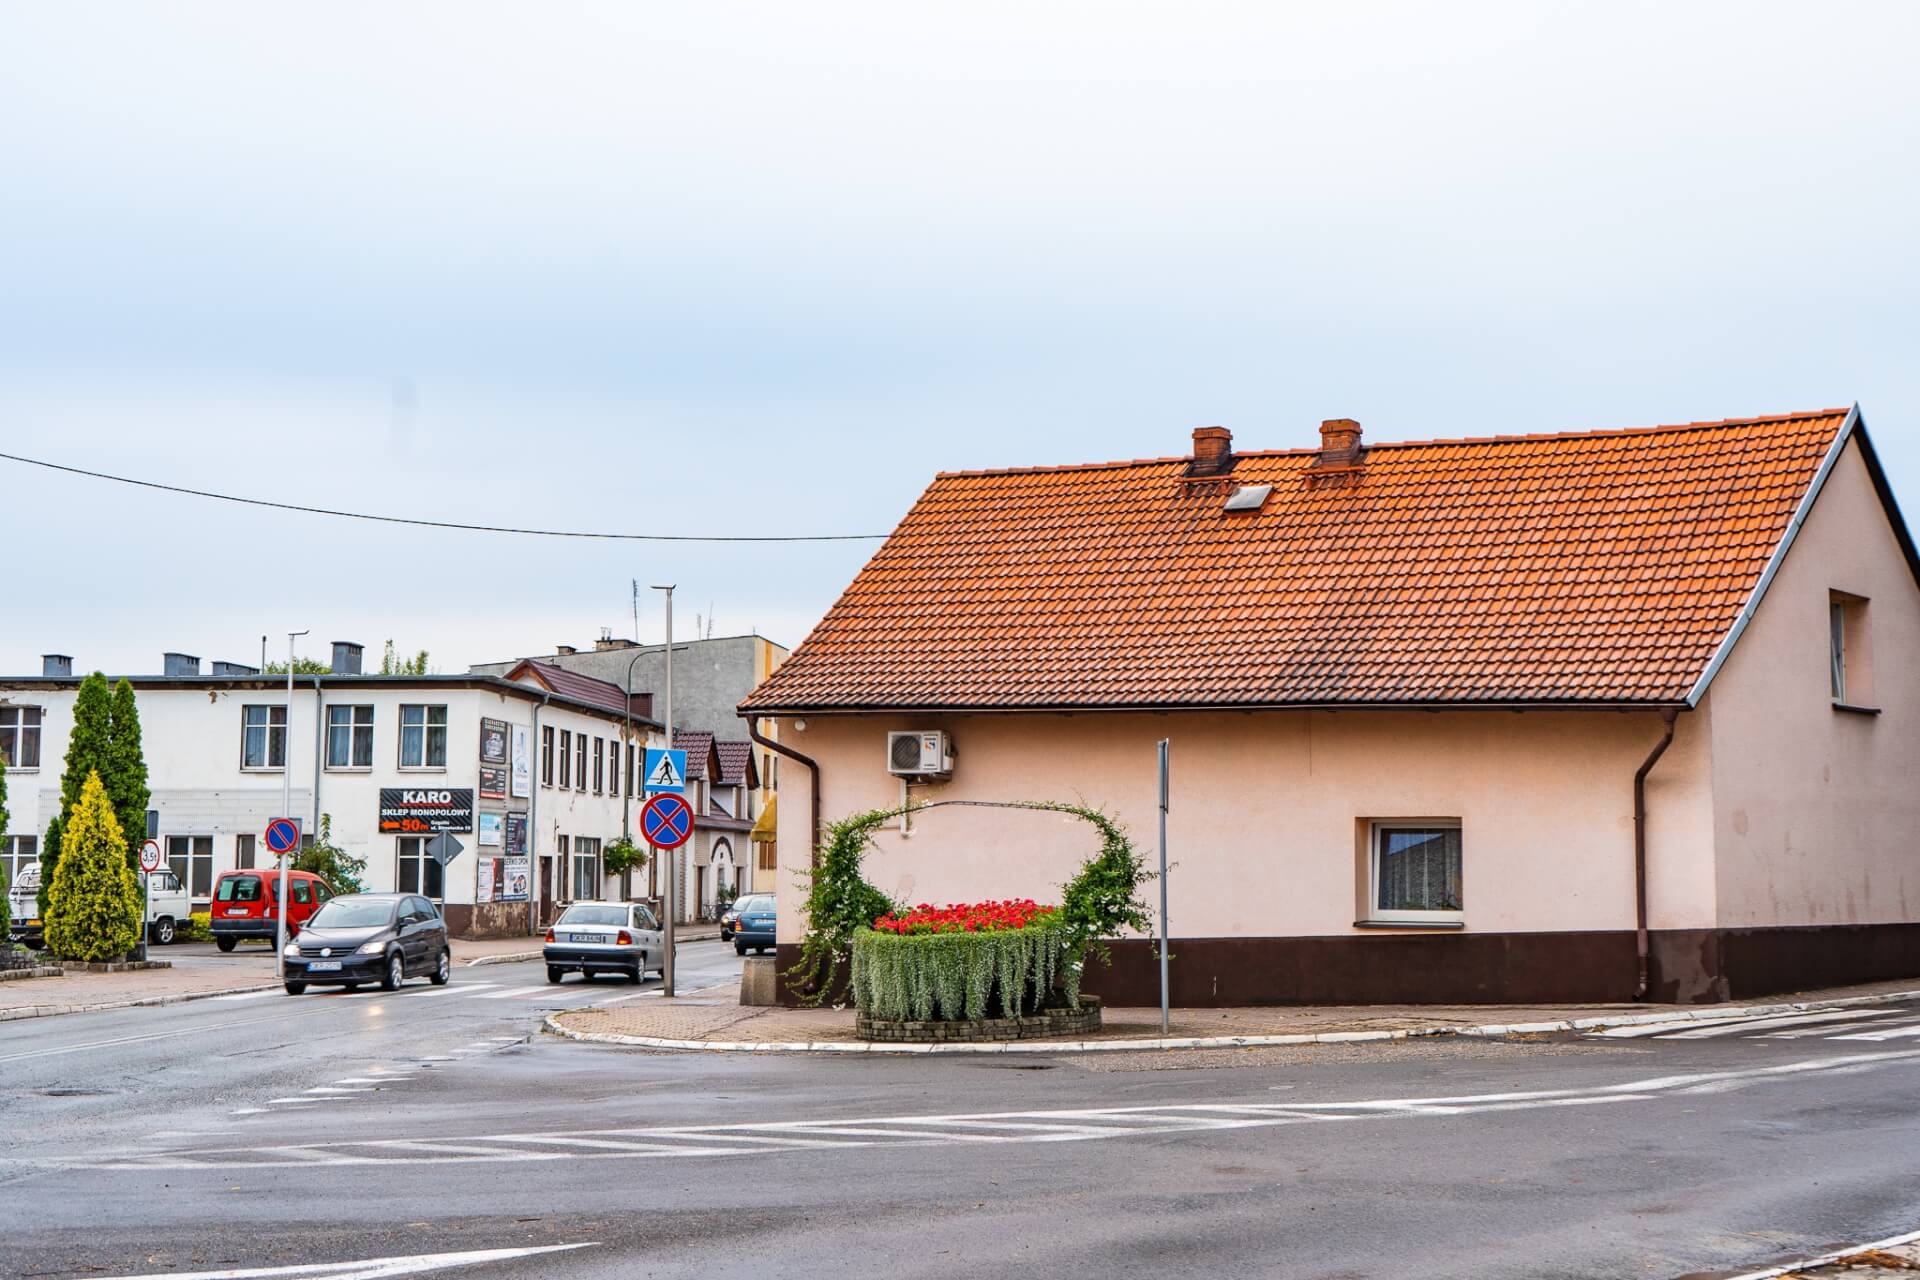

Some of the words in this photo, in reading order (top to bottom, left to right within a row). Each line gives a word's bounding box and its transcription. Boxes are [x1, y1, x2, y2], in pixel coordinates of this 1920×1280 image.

[402, 790, 452, 804] KARO
[381, 808, 409, 816] SKLEP
[410, 808, 471, 816] MONOPOLOWY
[143, 850, 157, 863] 3,5t
